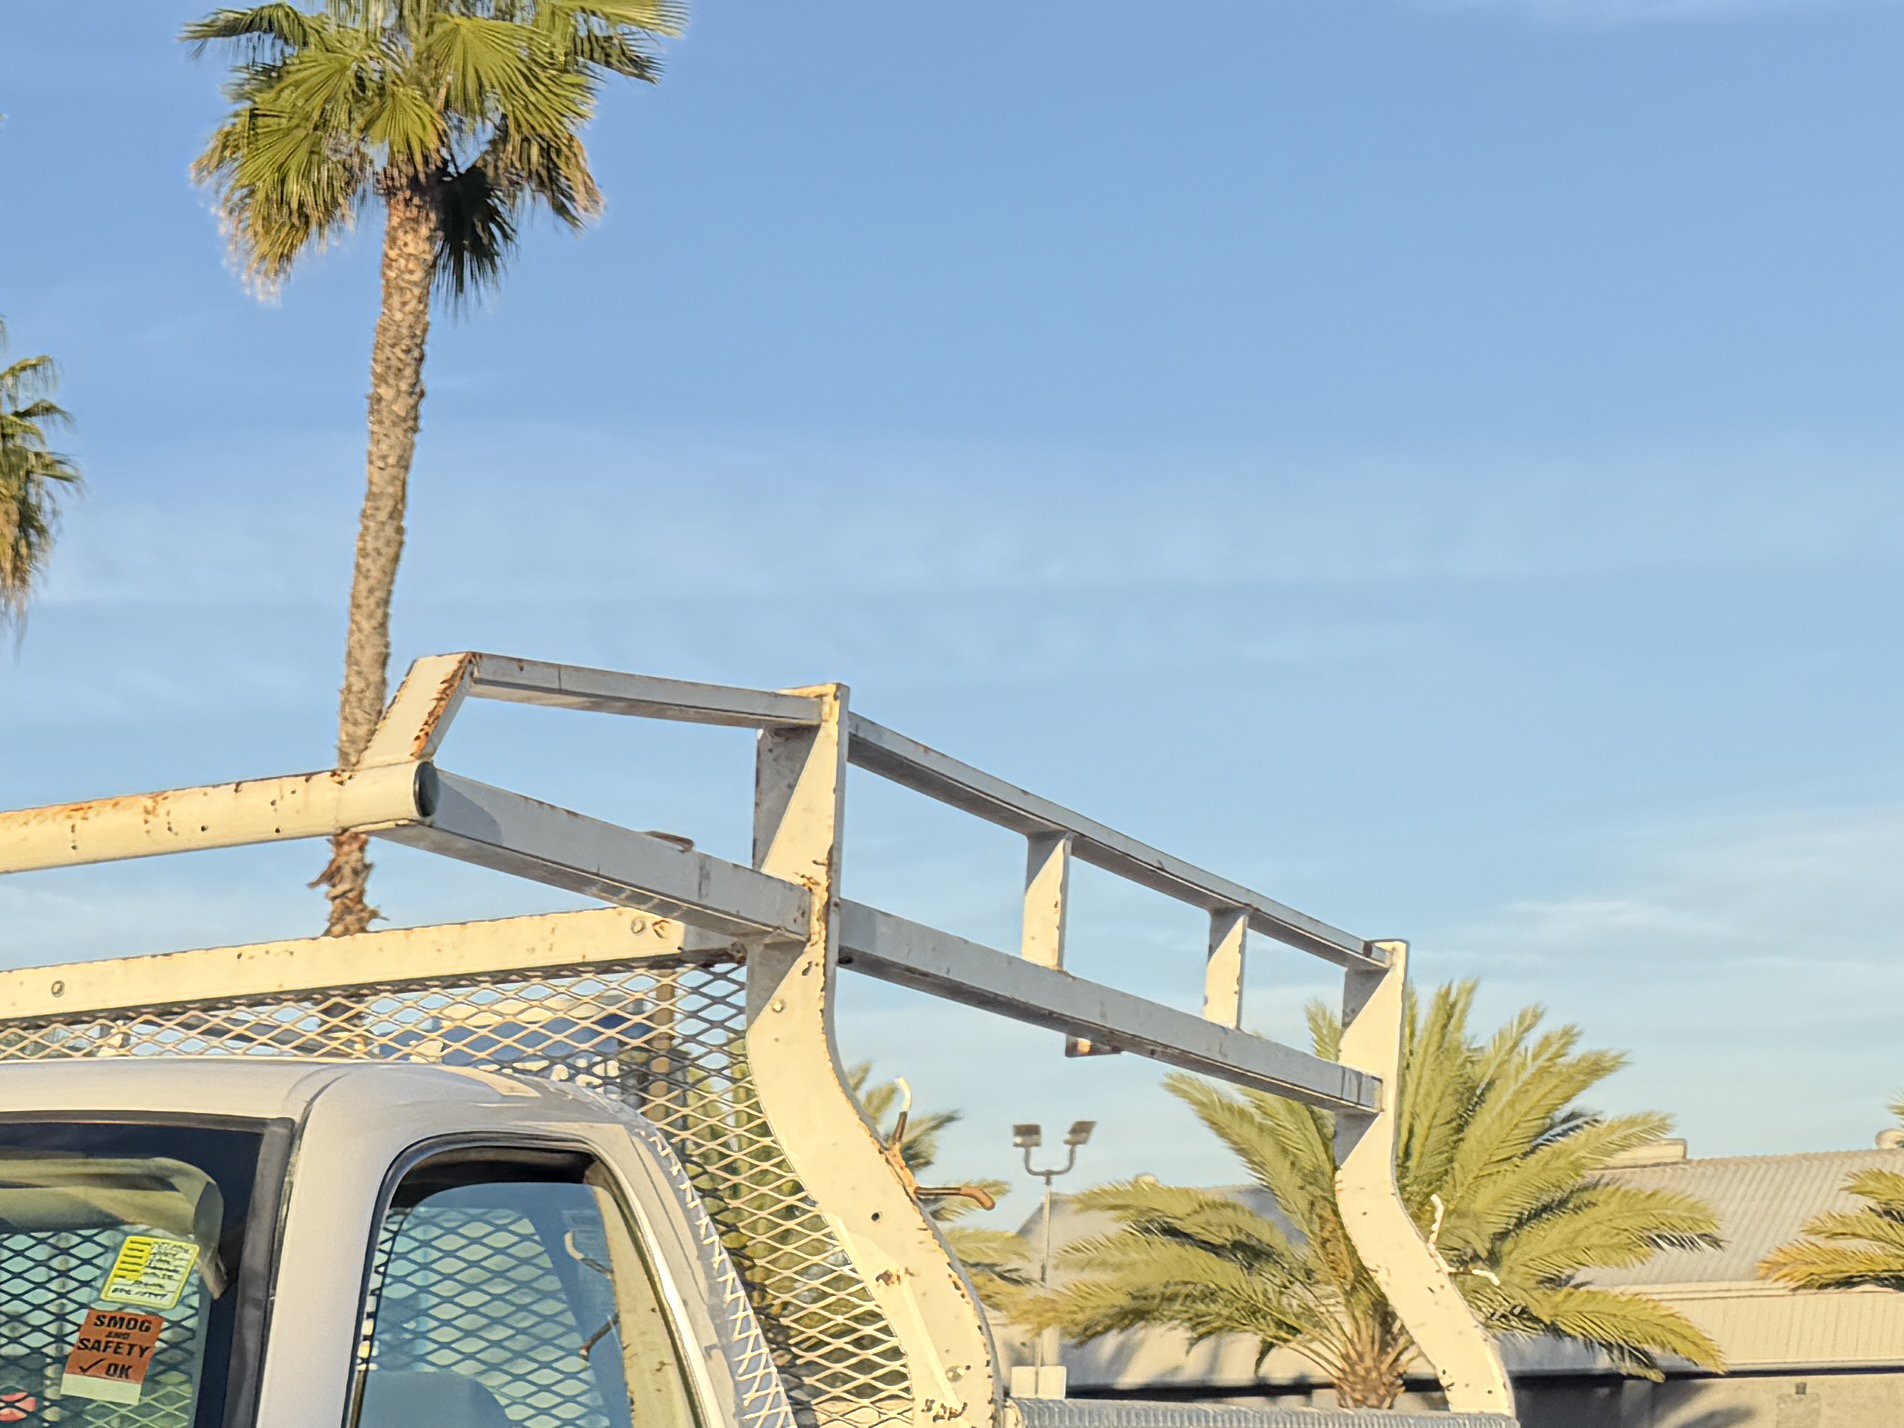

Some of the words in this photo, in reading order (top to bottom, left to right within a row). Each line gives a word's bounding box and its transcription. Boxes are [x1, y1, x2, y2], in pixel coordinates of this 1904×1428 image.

[93, 1314, 153, 1333] SMOG
[77, 1337, 151, 1358] SAFETY
[105, 1362, 133, 1380] OK
